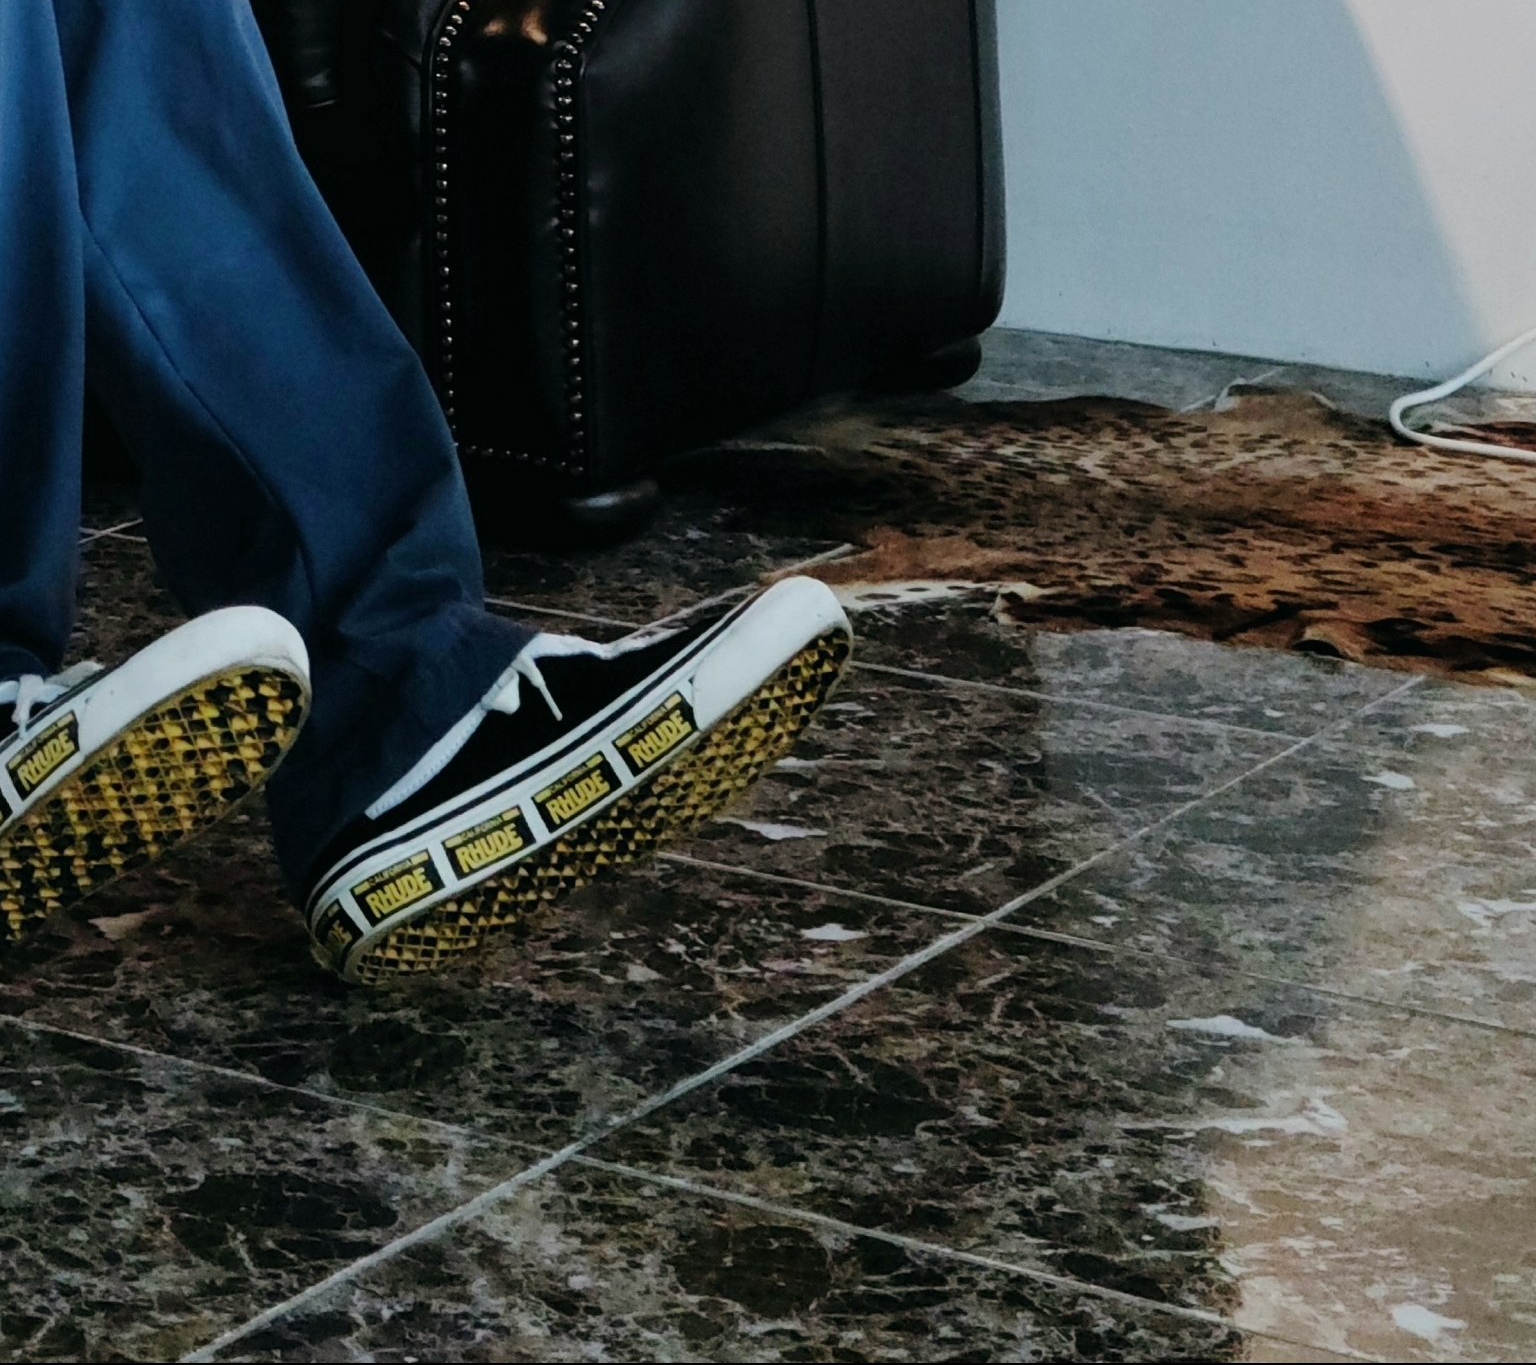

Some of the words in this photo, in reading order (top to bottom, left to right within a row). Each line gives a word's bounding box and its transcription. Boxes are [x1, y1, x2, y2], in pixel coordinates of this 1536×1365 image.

[17, 728, 76, 792] RHUDE
[627, 709, 692, 768] RHUDE
[545, 769, 611, 825] RHUDE
[455, 822, 524, 873] RHUDE
[365, 867, 433, 919] RHUDE
